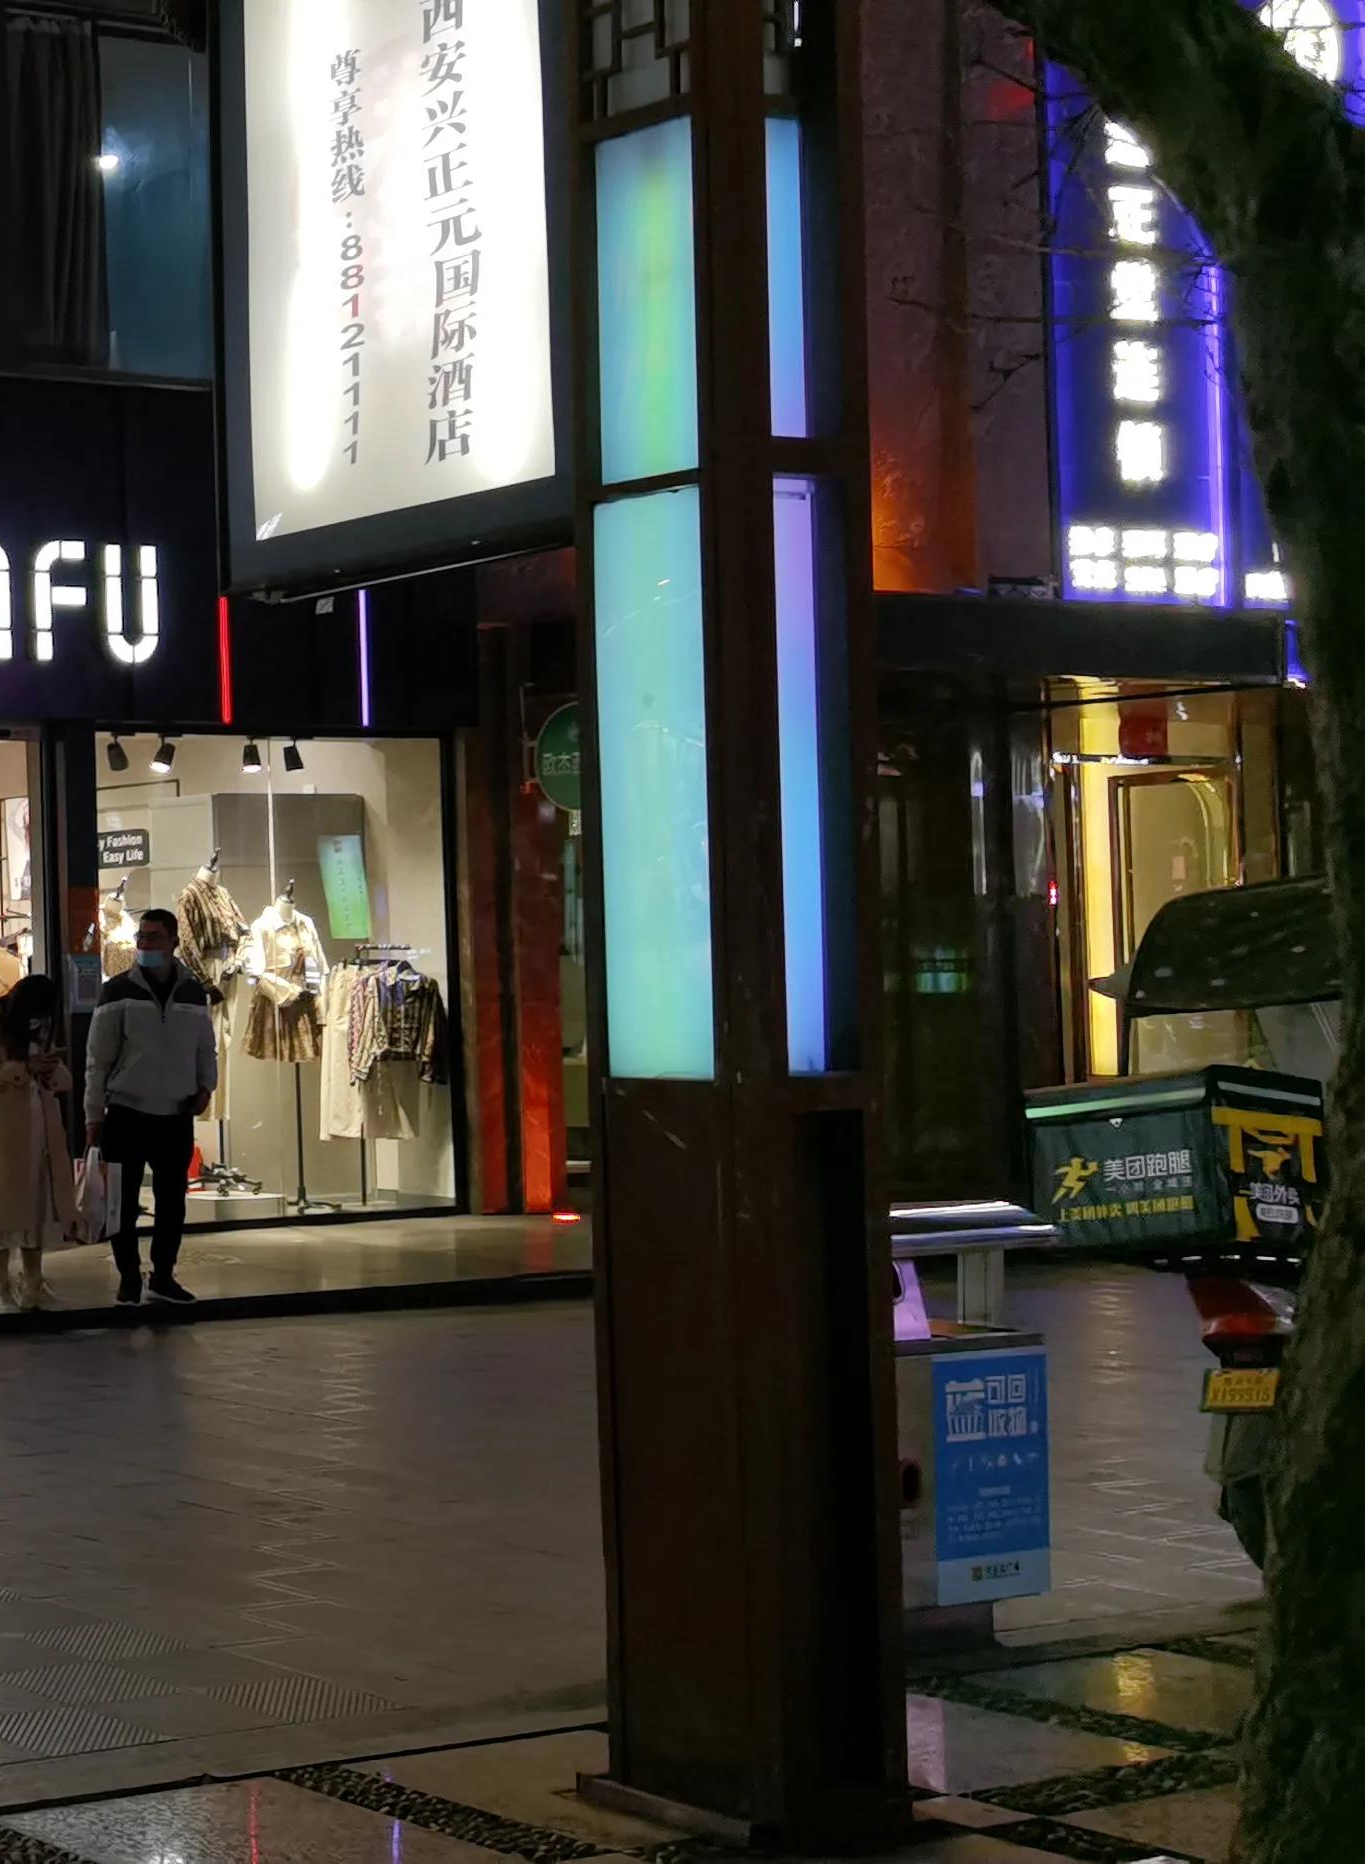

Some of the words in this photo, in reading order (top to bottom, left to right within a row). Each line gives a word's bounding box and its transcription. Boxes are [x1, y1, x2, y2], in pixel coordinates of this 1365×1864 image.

[418, 0, 482, 467] 西安兴正元国际酒店
[106, 834, 143, 848] Fashion
[102, 851, 125, 864] Easy
[126, 848, 144, 861] Life
[1103, 1149, 1193, 1182] 美团跑腿
